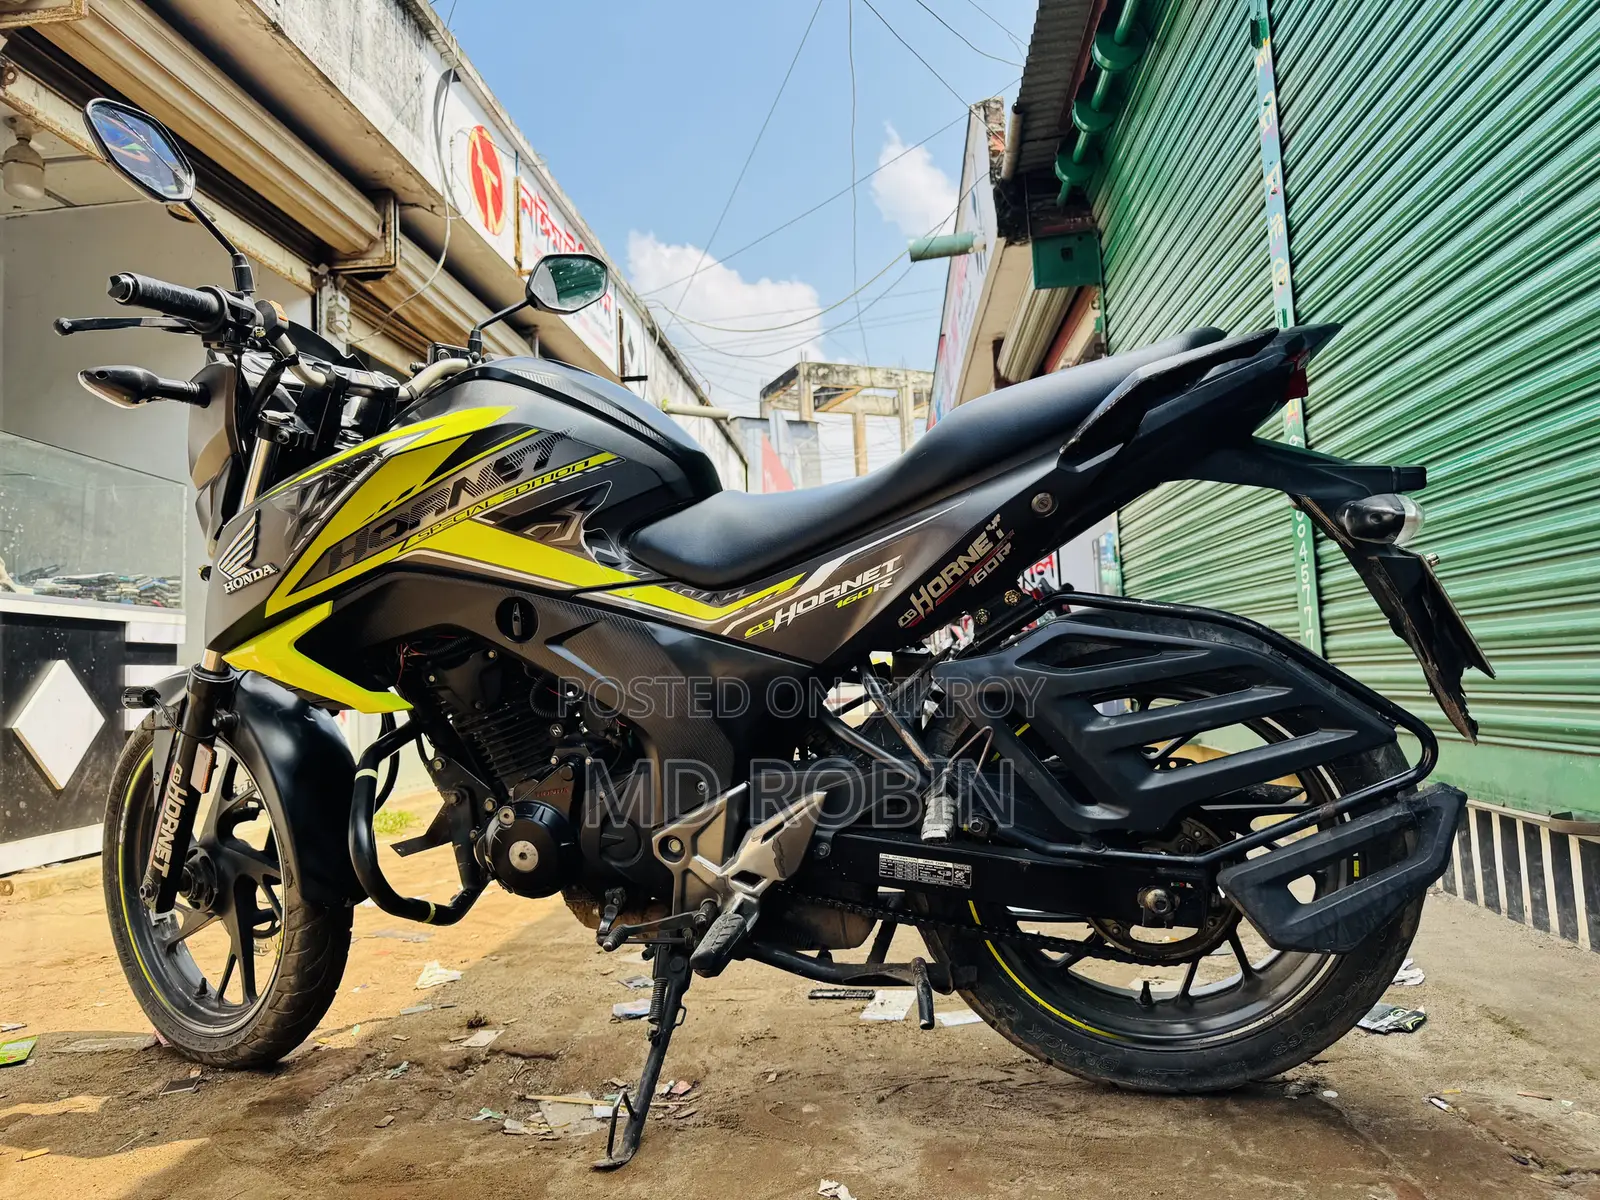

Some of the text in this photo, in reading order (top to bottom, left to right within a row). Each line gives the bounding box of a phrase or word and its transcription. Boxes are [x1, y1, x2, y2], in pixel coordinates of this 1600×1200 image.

[417, 501, 497, 539] SPECIAL
[223, 564, 276, 594] HONDA
[772, 555, 902, 632] HORNET
[835, 577, 893, 609] 160R
[153, 781, 188, 878] HORNET
